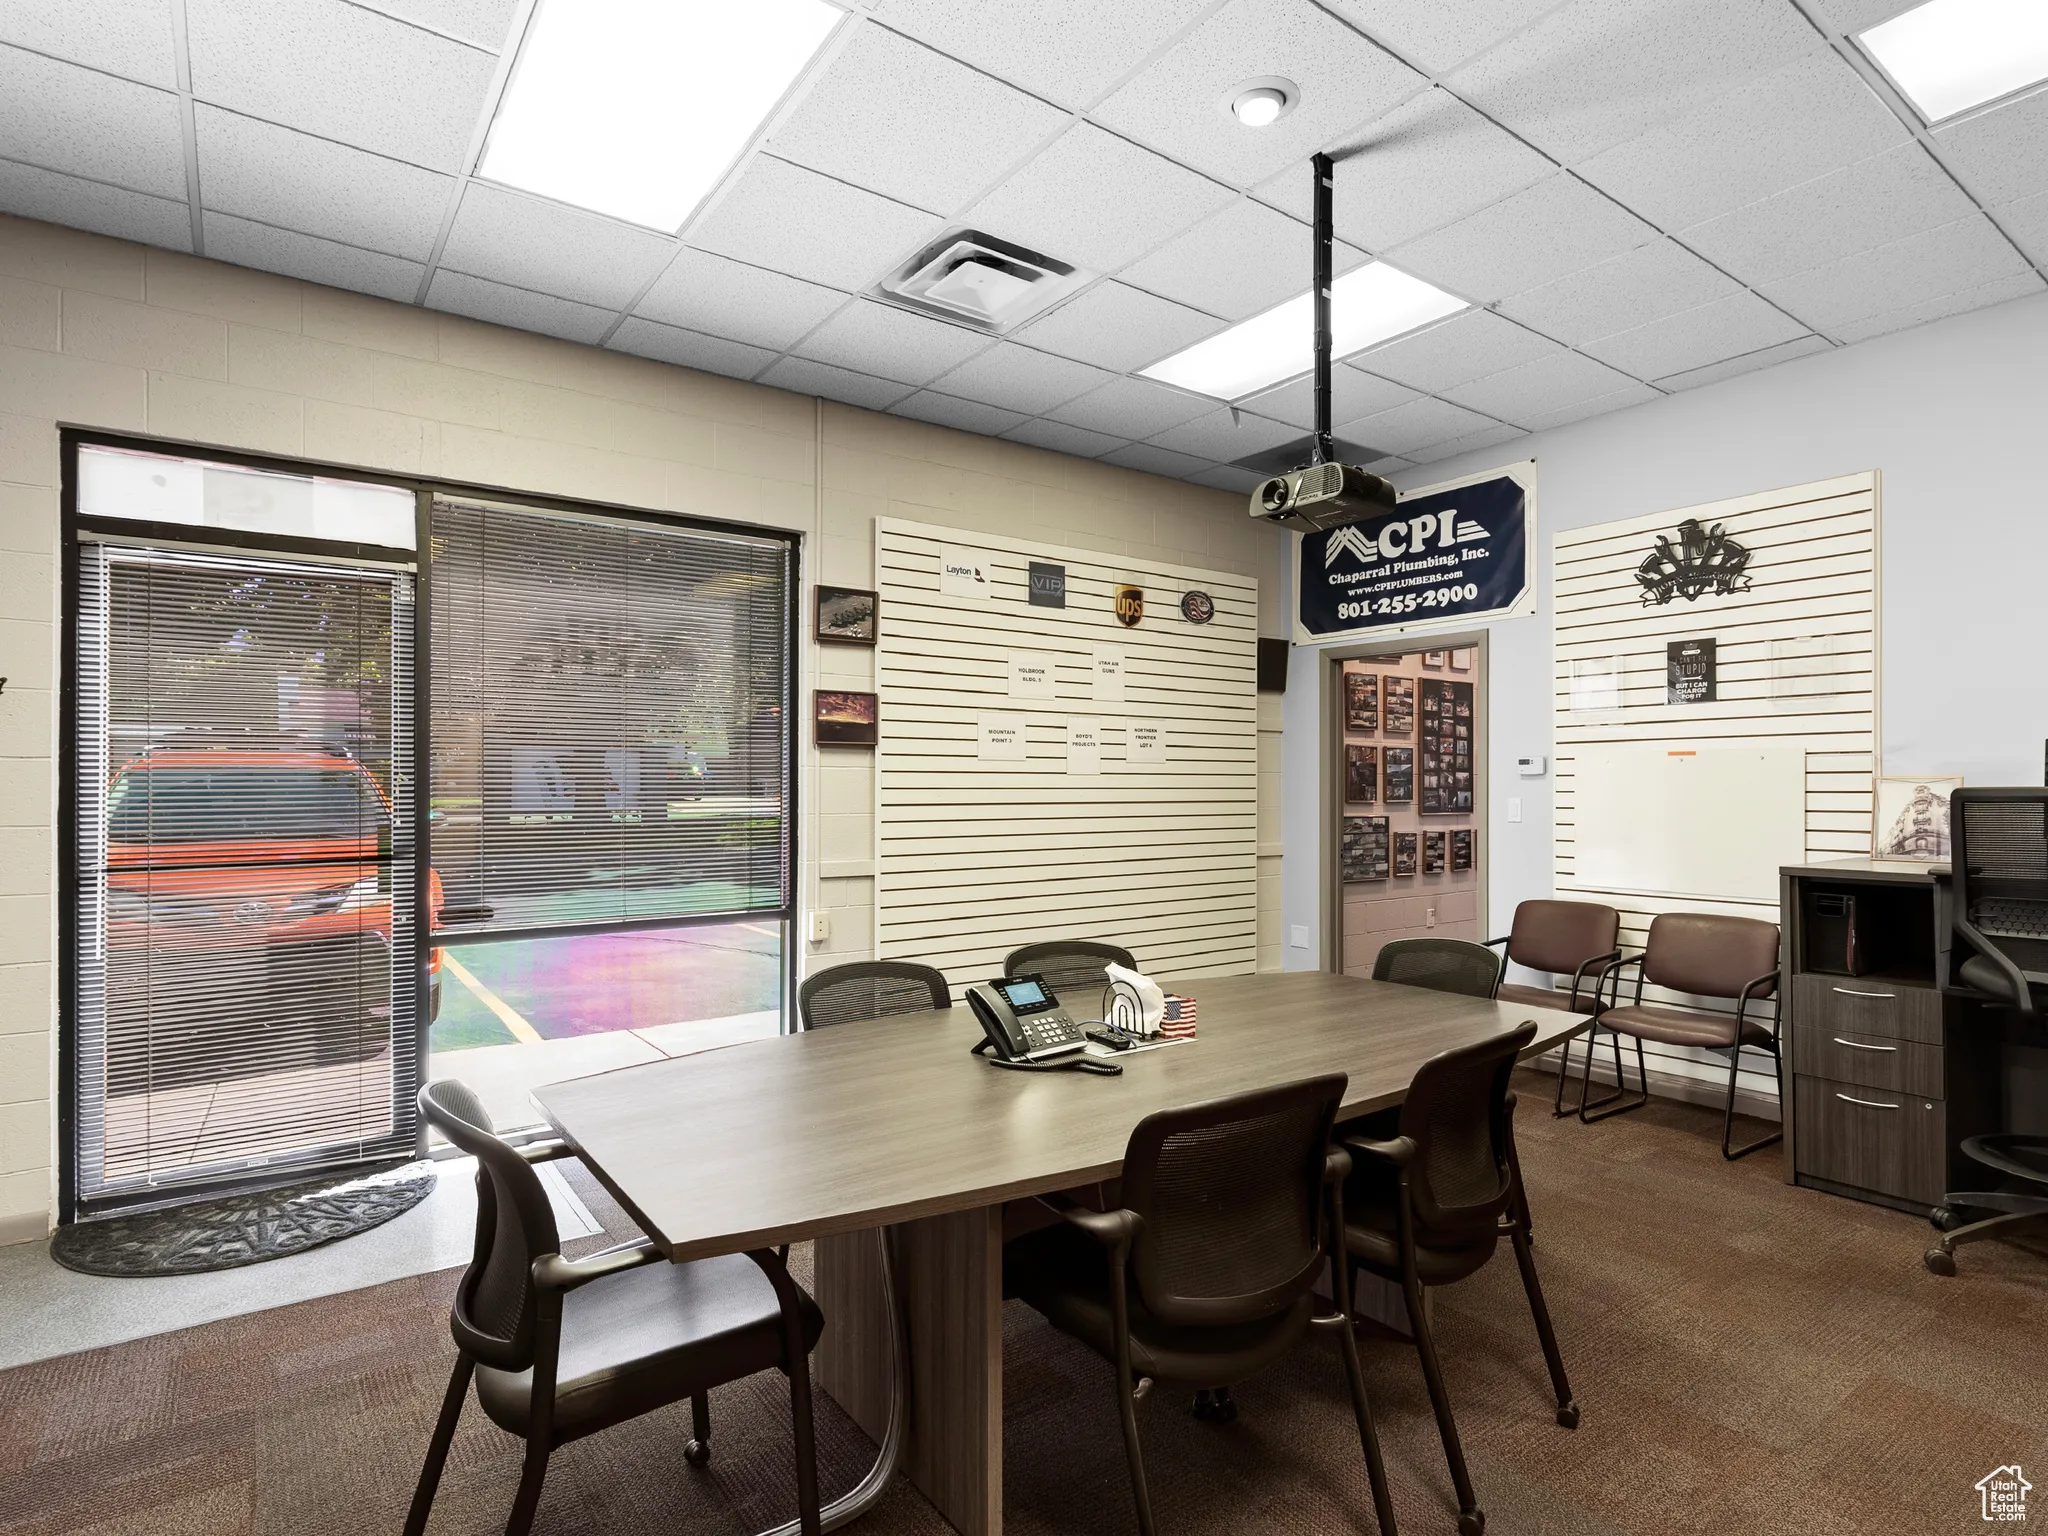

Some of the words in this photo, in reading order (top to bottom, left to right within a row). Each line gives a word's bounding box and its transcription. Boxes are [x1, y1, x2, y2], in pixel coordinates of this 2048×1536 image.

[1378, 509, 1457, 558] CPI
[946, 564, 972, 576] Layton
[1328, 564, 1390, 585] Chaparral
[1393, 553, 1459, 575] Plumbing,
[1461, 547, 1489, 560] Inc.
[1033, 576, 1062, 591] VIP
[1348, 570, 1463, 596] www.CPIPLUMBERS.com
[1117, 597, 1141, 622] ups
[1337, 583, 1478, 619] 801-255-2900
[1675, 663, 1707, 675] STUPID
